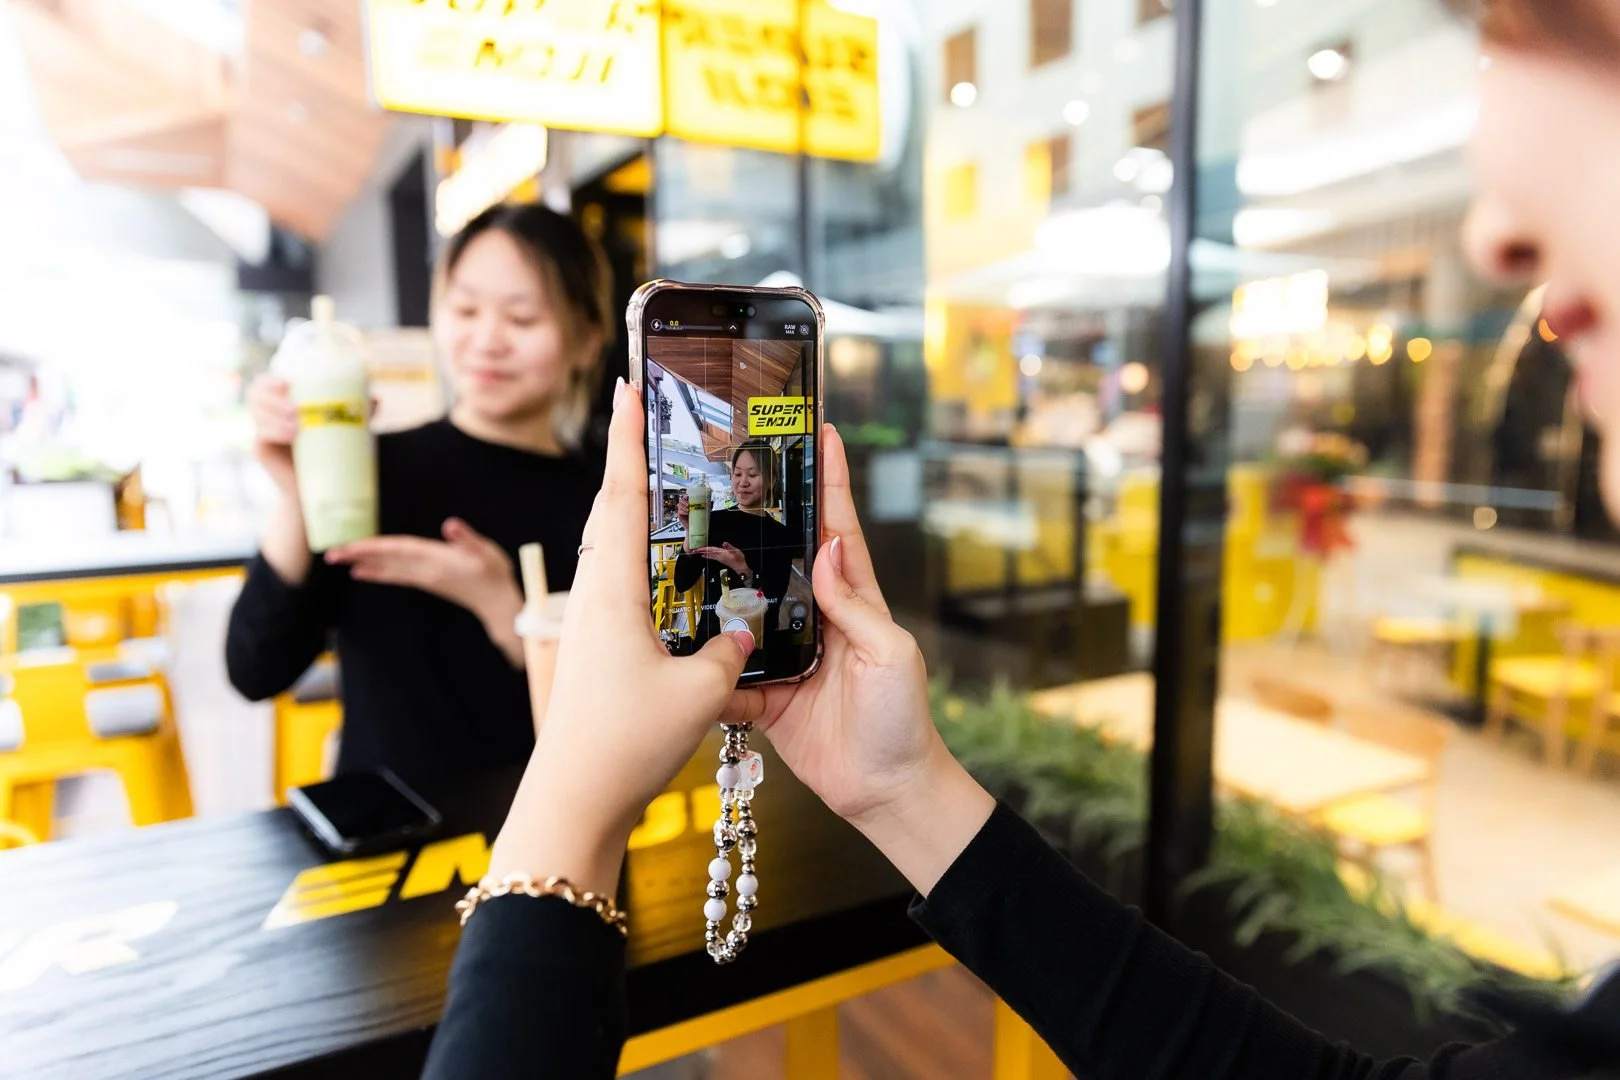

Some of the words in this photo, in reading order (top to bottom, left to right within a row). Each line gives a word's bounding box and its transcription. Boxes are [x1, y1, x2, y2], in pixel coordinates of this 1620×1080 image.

[750, 404, 804, 415] SUPER
[755, 416, 797, 427] EMOJI
[700, 603, 717, 611] VIDEO
